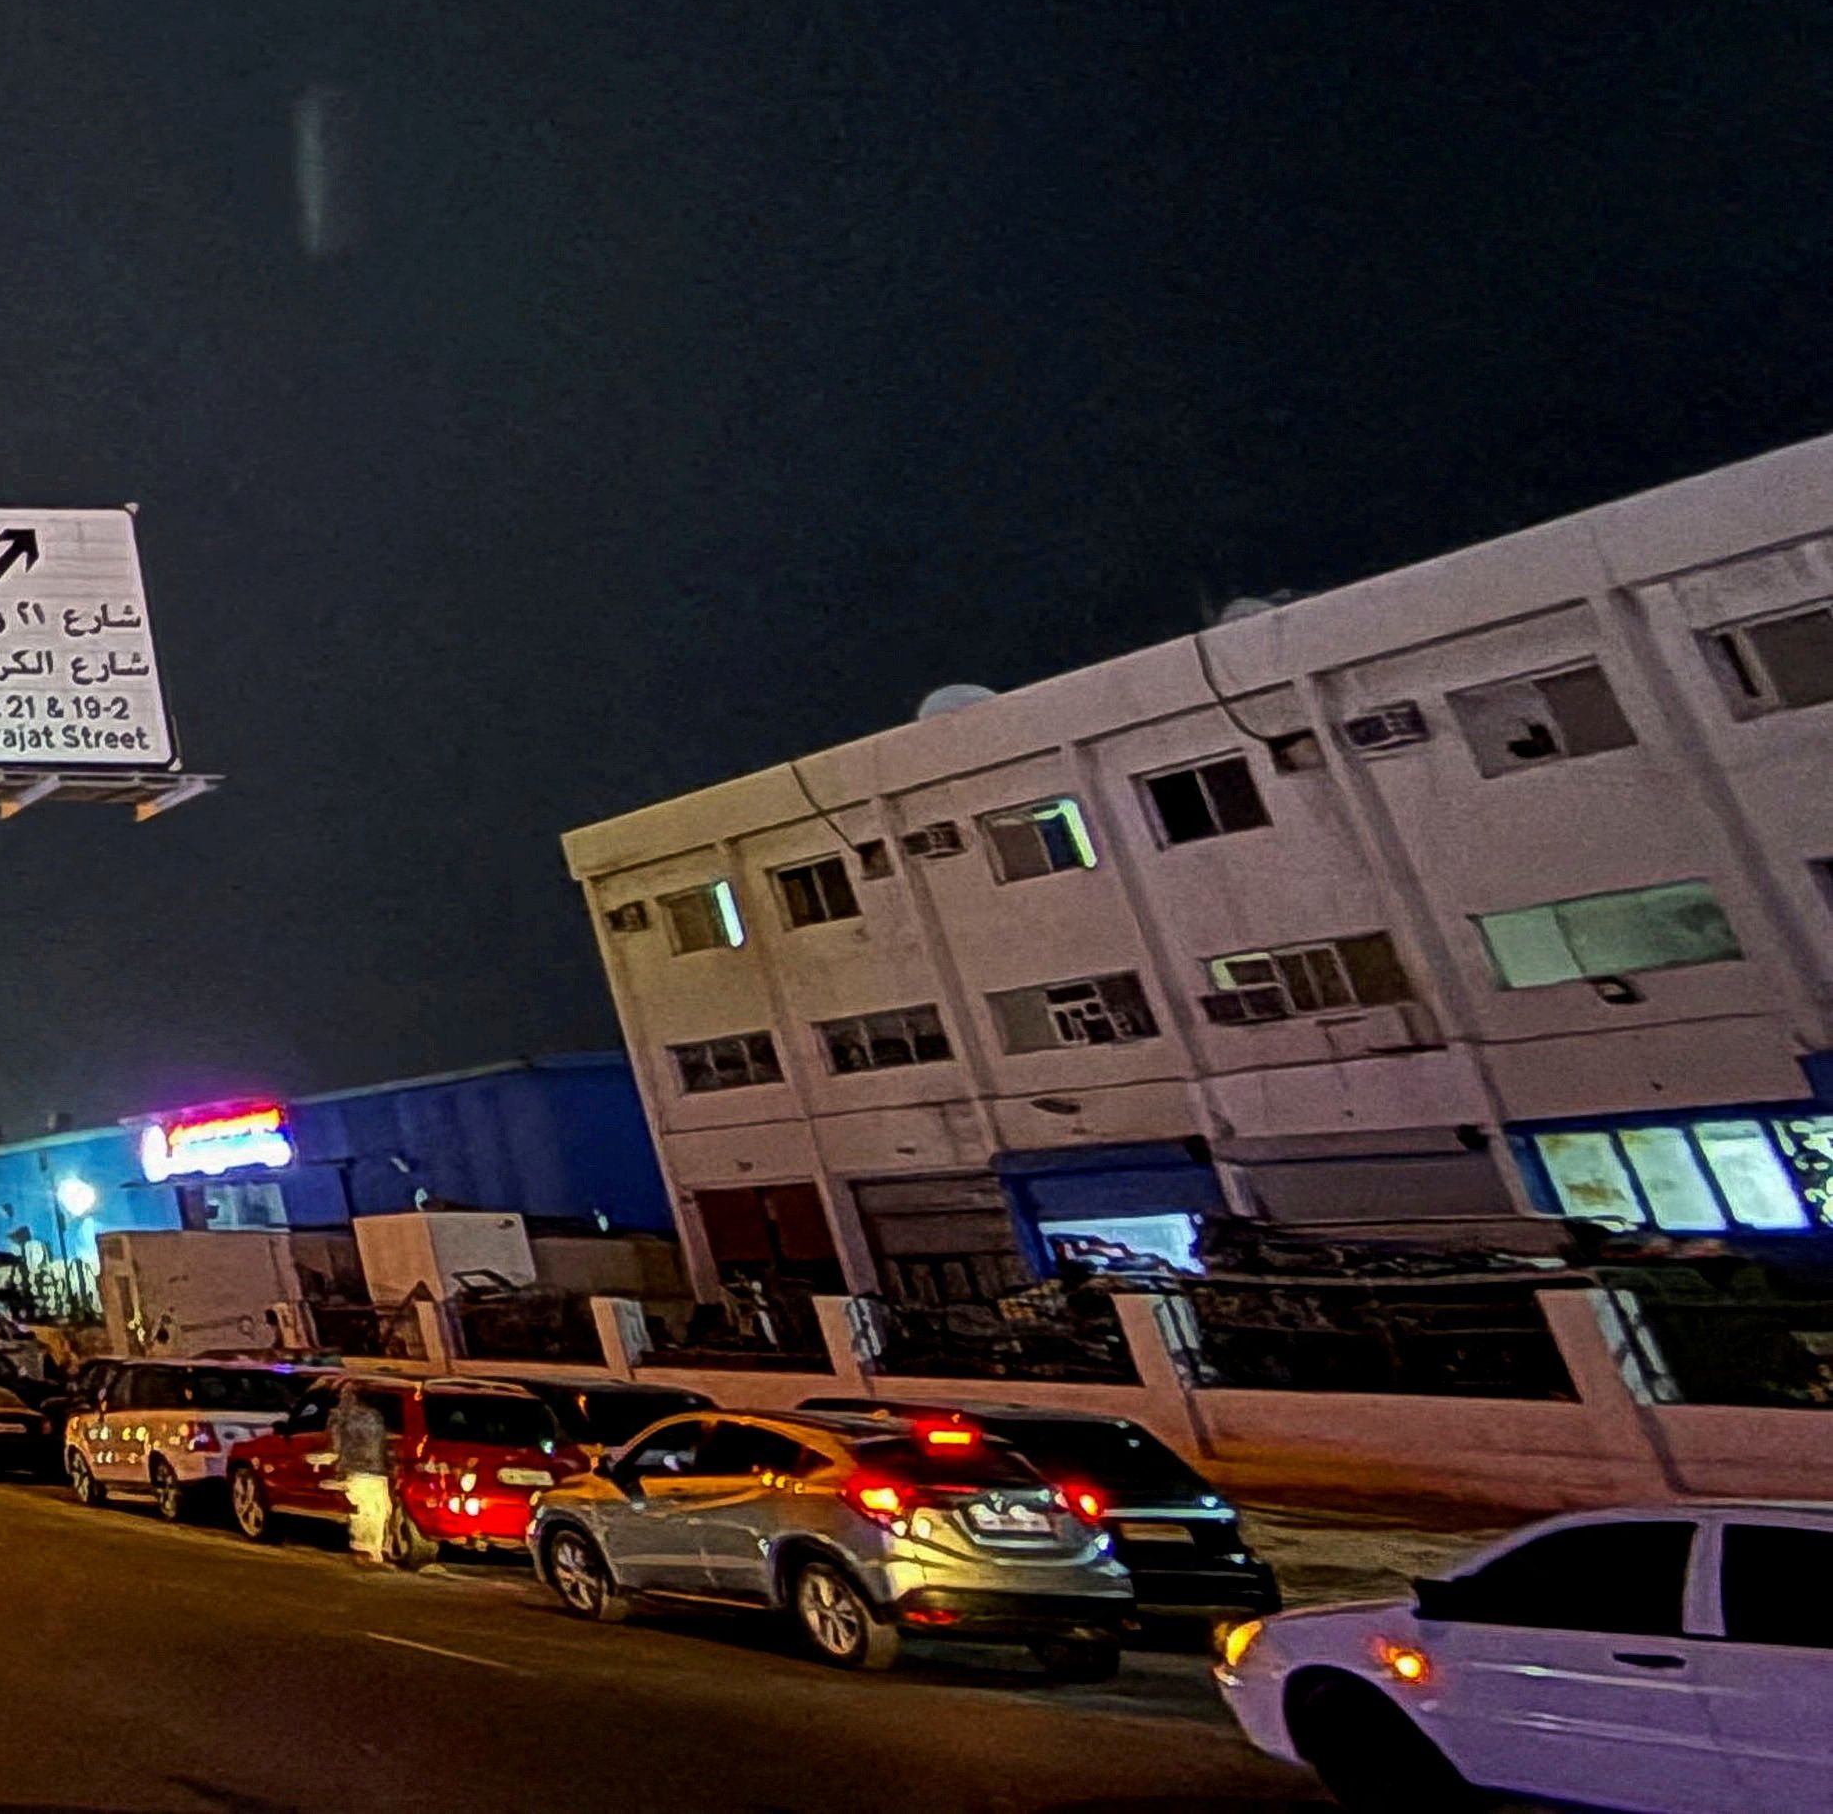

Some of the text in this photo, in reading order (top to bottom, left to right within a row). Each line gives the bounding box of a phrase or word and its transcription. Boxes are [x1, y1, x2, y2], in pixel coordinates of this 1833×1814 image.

[62, 603, 142, 637] شارع
[70, 651, 150, 685] شارع
[6, 695, 34, 718] 21
[46, 696, 64, 719] &
[72, 696, 130, 720] 19-2
[62, 724, 150, 750] Street
